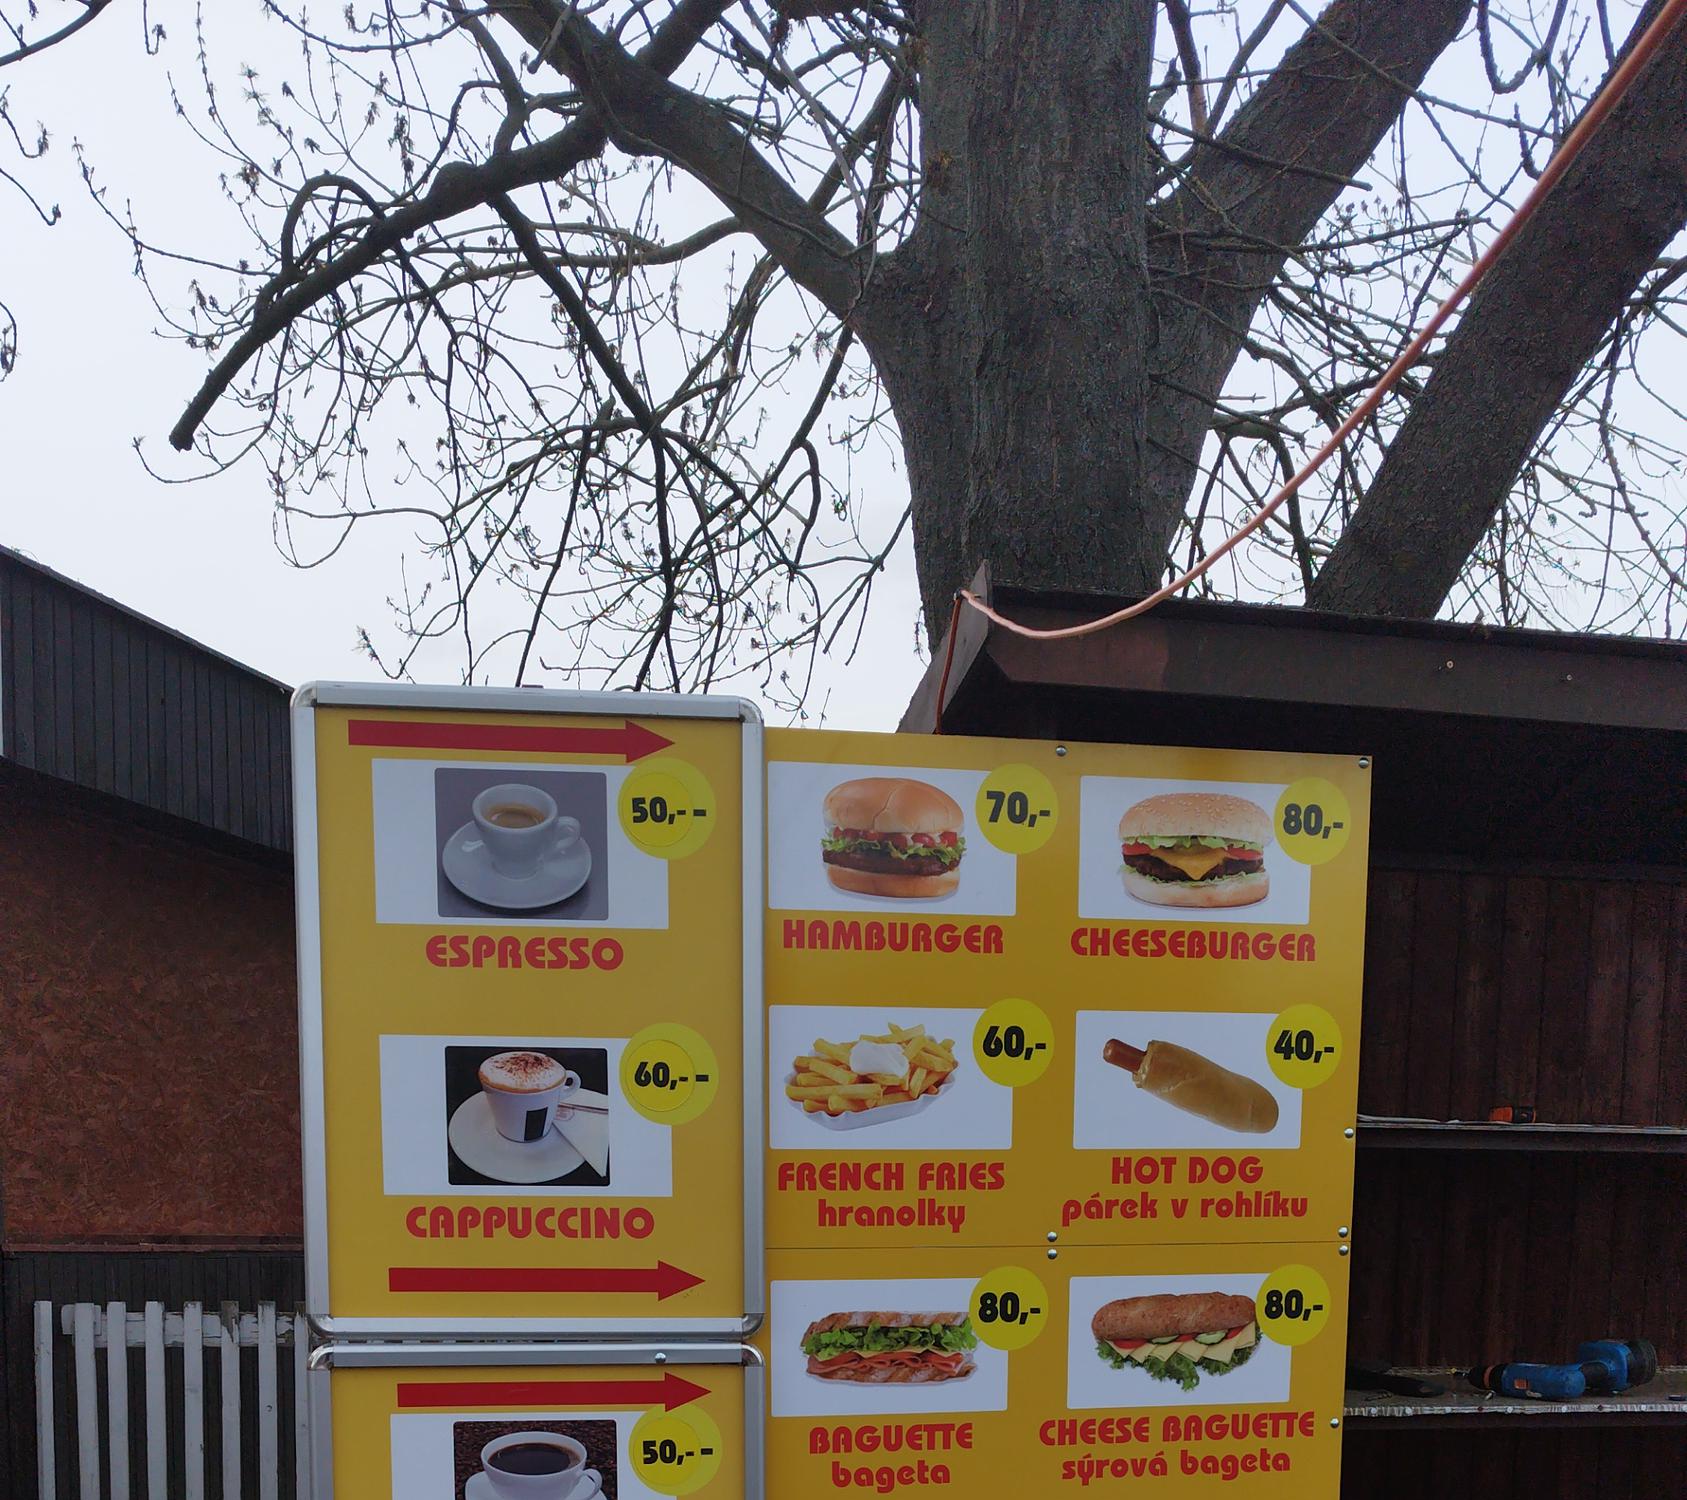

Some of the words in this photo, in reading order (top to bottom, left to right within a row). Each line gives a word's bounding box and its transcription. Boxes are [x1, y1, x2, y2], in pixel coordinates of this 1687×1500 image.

[986, 790, 1051, 828] 70,-
[1282, 803, 1343, 839] 80,-
[426, 935, 624, 971] ESPRESSO
[783, 919, 1004, 954] HAMBURGER
[1070, 927, 1315, 961] CHEESEBURGER
[982, 1025, 1047, 1061] 60,-
[1273, 1029, 1335, 1064] 40,-
[777, 1161, 905, 1192] FRENCH
[918, 1162, 1005, 1191] FRIES
[1111, 1156, 1178, 1185] HOT
[1187, 1155, 1264, 1185] DOG
[405, 1205, 655, 1239] CAPPUCCINO
[817, 1197, 966, 1234] hranolky
[1061, 1191, 1158, 1228] párek
[1170, 1198, 1189, 1219] v
[1200, 1190, 1308, 1219] rohlíku
[978, 1291, 1041, 1325] 80,-
[1264, 1289, 1324, 1322] 80,-
[809, 1422, 973, 1455] BAGUETTE
[1039, 1416, 1150, 1447] CHEESE
[1162, 1410, 1315, 1443] BAGUETTE
[831, 1459, 951, 1494] bageta
[1061, 1450, 1168, 1487] sýrová
[1179, 1447, 1291, 1482] bageta
